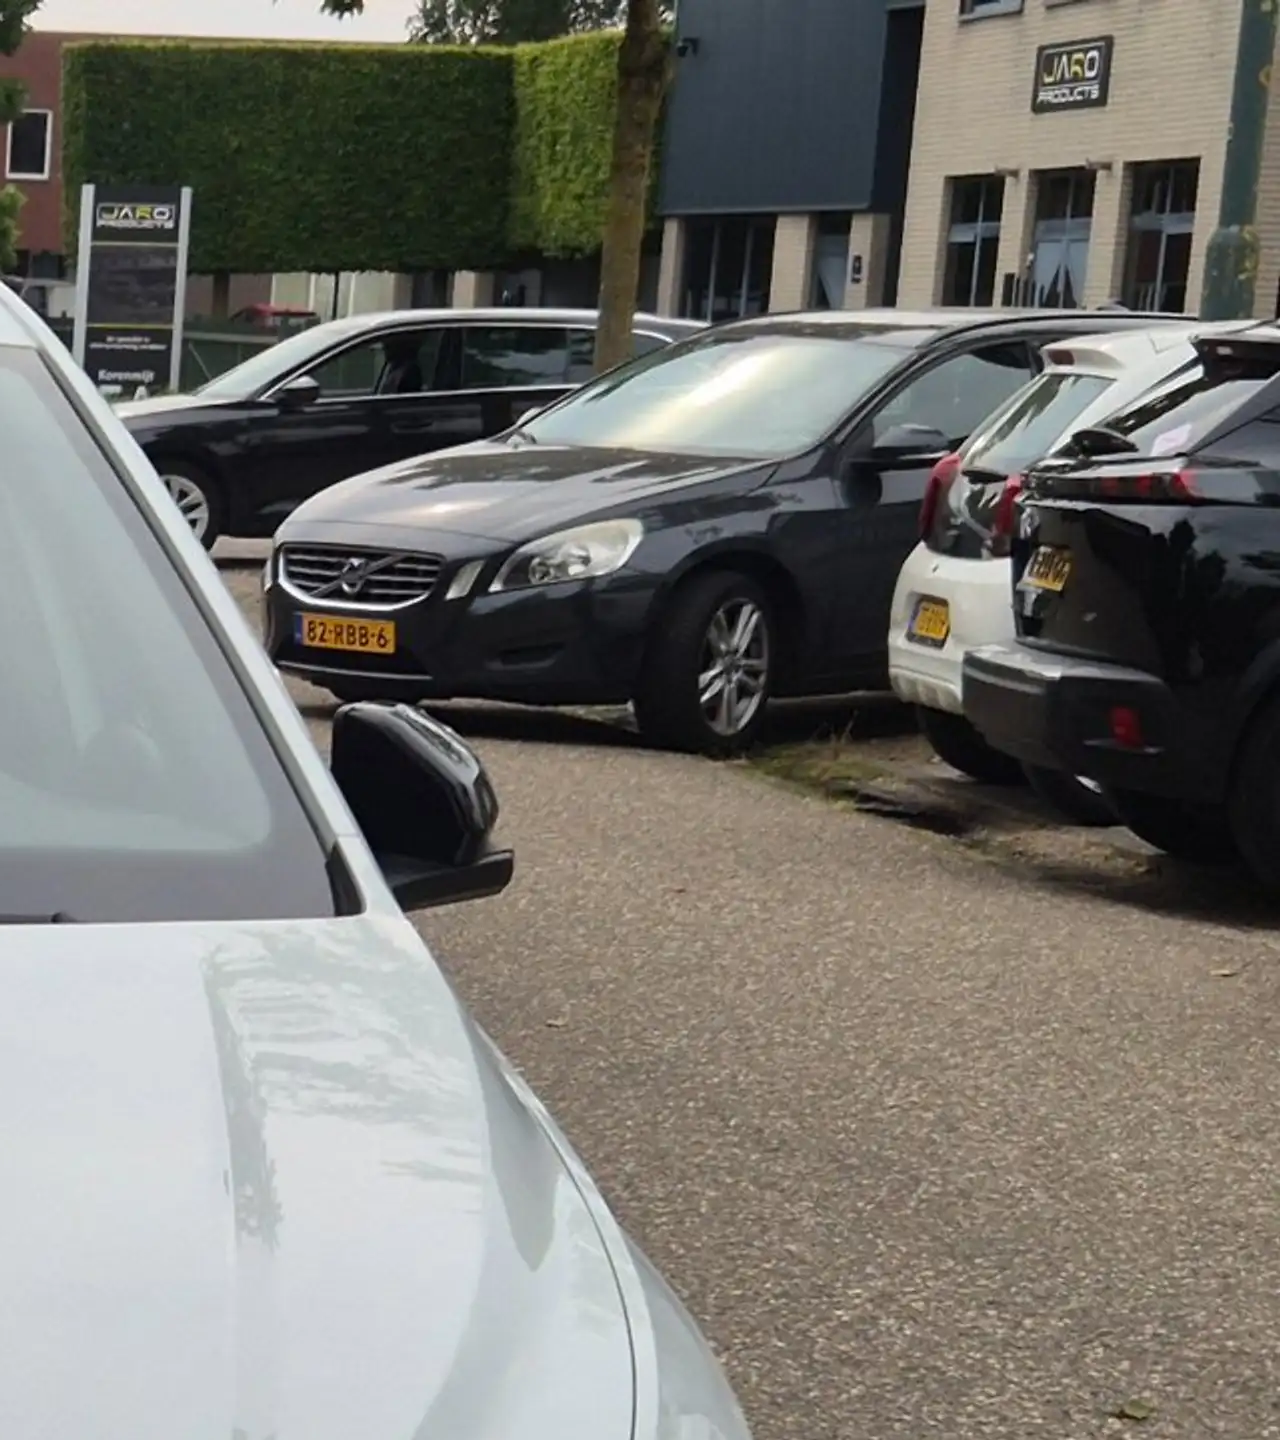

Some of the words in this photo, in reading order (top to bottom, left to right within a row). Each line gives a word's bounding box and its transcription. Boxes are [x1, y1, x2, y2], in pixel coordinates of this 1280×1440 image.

[1042, 50, 1100, 84] JARO
[100, 205, 171, 220] JARO
[307, 619, 388, 649] 82-RBB-6
